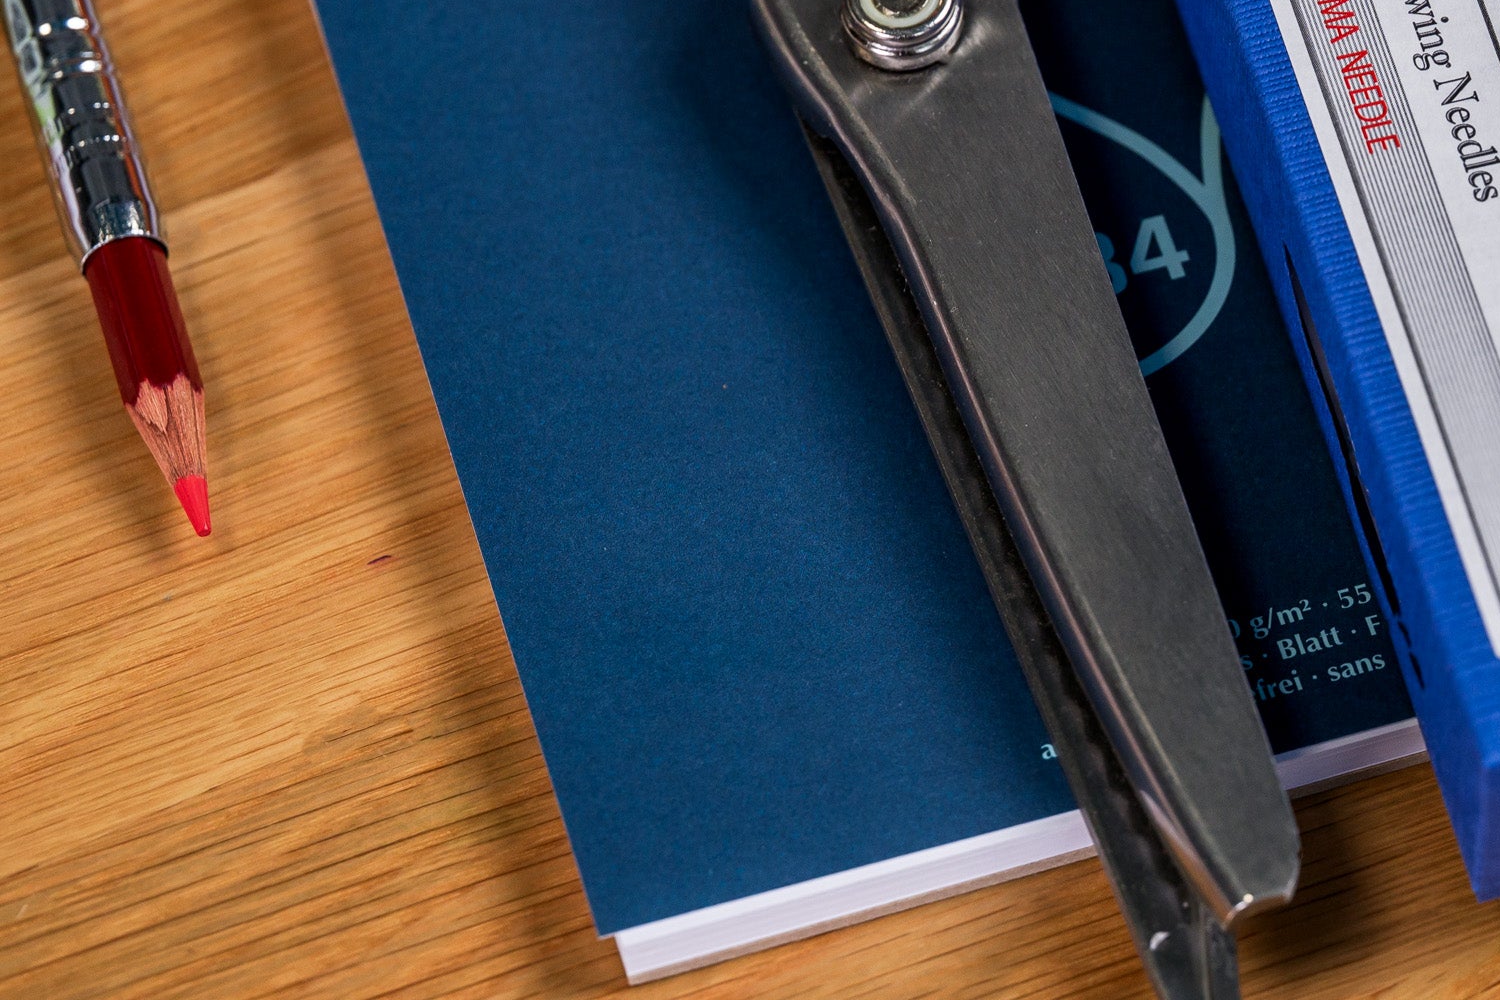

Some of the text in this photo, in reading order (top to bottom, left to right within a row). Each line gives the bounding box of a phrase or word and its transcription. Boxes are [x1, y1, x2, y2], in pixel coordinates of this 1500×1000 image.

[1336, 50, 1400, 154] NEEDLE
[1338, 583, 1371, 608] 55
[1277, 627, 1343, 660] Blatt
[1328, 654, 1385, 681] sans
